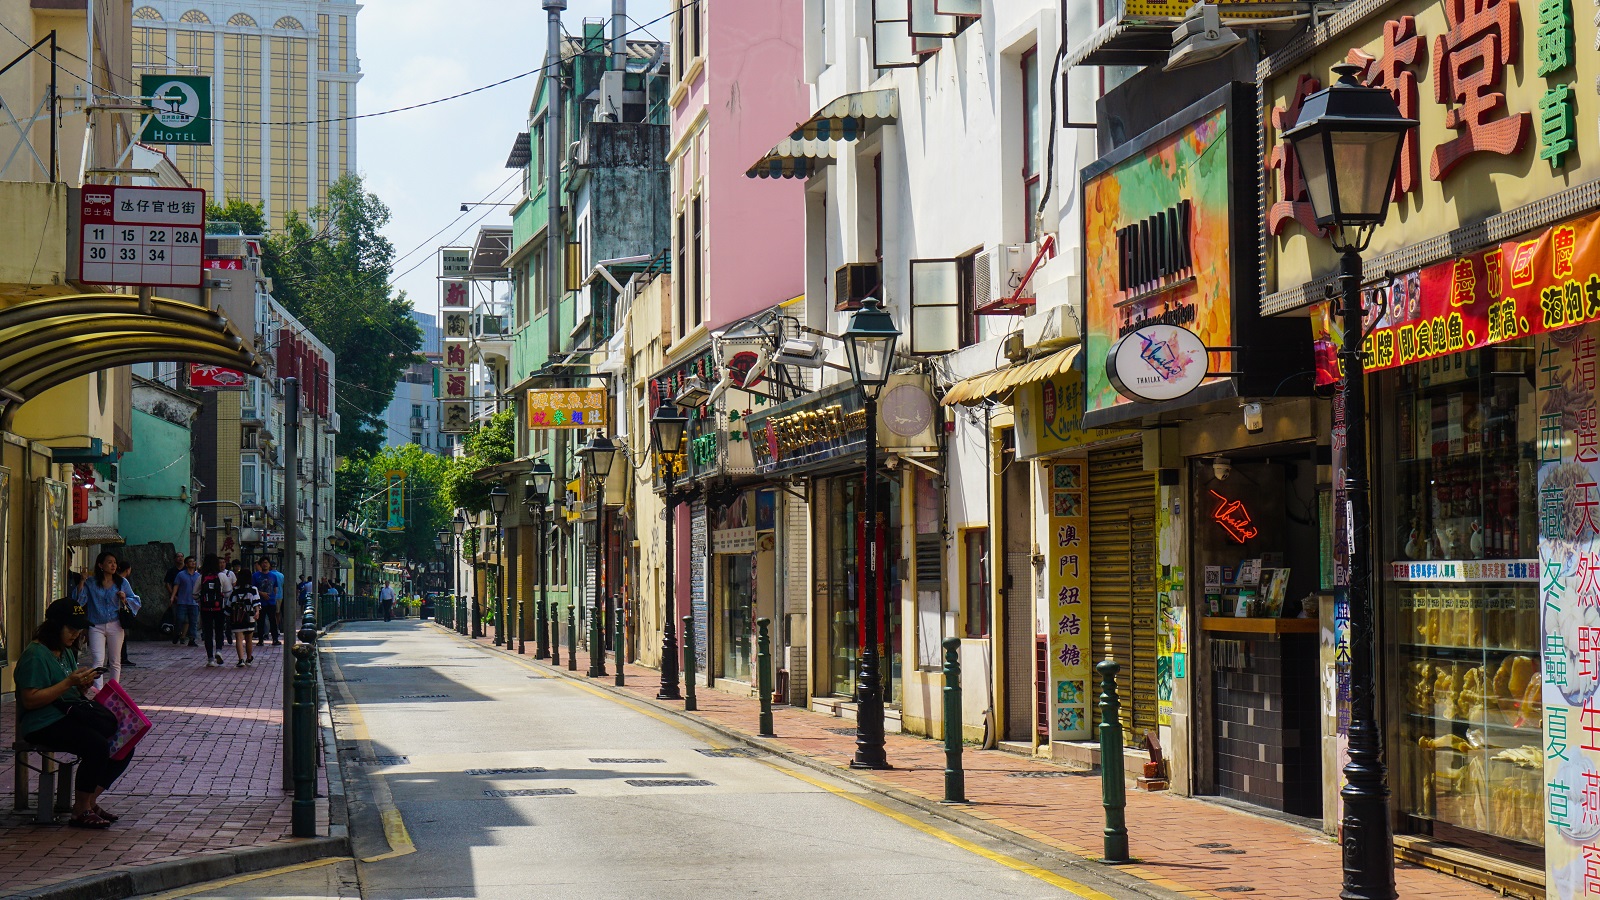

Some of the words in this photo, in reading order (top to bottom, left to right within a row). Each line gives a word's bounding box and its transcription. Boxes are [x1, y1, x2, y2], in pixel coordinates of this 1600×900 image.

[154, 130, 196, 141] HOTEL
[84, 207, 111, 217] 巴士站
[120, 199, 195, 214] 氹仔官也街
[93, 228, 105, 241] 11
[120, 230, 135, 242] 15
[149, 230, 166, 243] 22
[175, 231, 199, 244] 28A
[90, 247, 106, 260] 30
[119, 248, 136, 261] 33
[149, 249, 165, 262] 34
[1137, 376, 1161, 384] THAILAX
[1058, 524, 1081, 667] 澳門紐結糖
